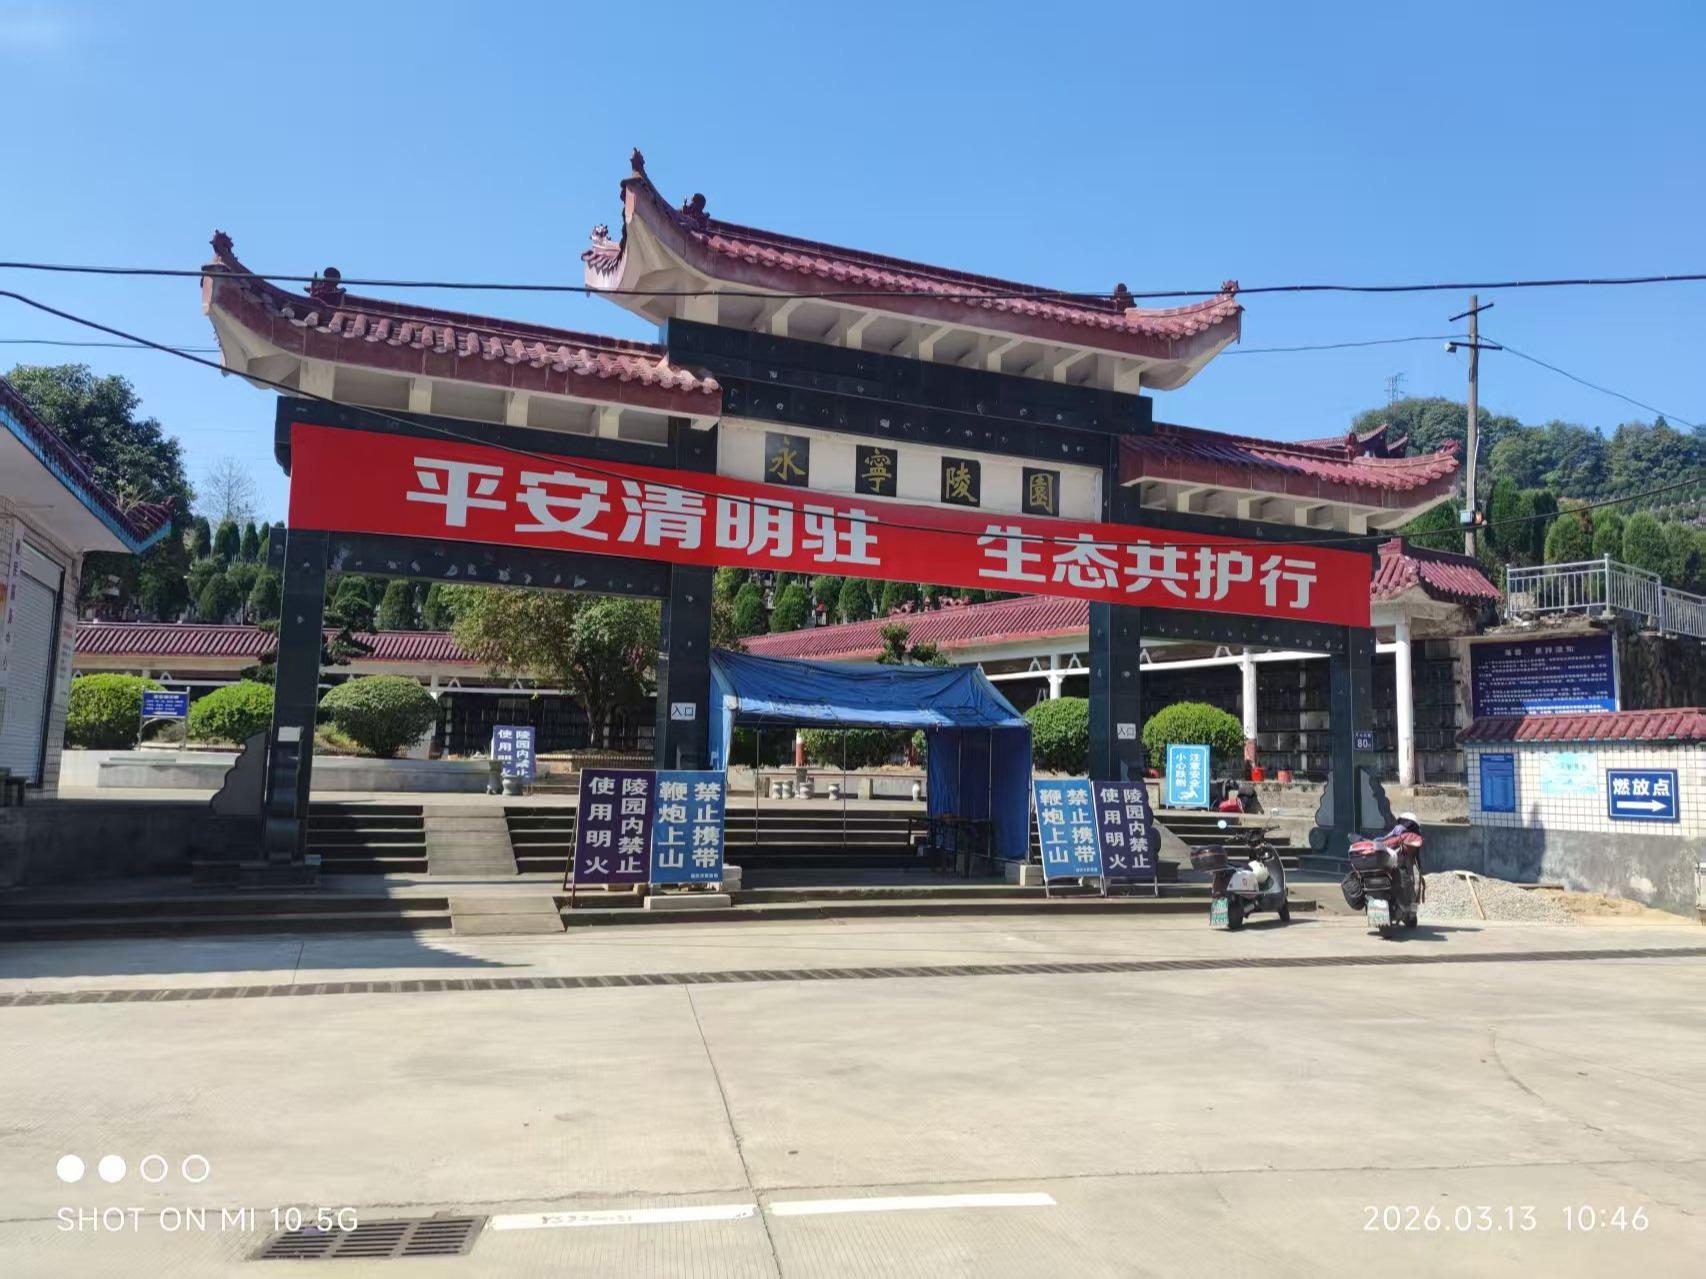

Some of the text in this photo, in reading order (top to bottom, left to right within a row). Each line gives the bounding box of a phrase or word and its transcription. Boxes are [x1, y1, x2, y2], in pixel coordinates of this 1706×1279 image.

[405, 456, 1317, 609] 平安清明驻 生态共护行
[672, 705, 694, 717] 入口
[583, 776, 615, 875] 使用明火
[616, 777, 648, 874] 陵园内禁止
[657, 781, 688, 869] 鞭炮上山
[692, 781, 721, 869] 禁止携带
[1039, 788, 1069, 863] 鞭炮上山
[1067, 788, 1096, 864] 禁止携带
[1612, 777, 1671, 797] 燃放点
[1100, 788, 1127, 869] 使用明火
[1123, 788, 1151, 869] 陵园内禁止
